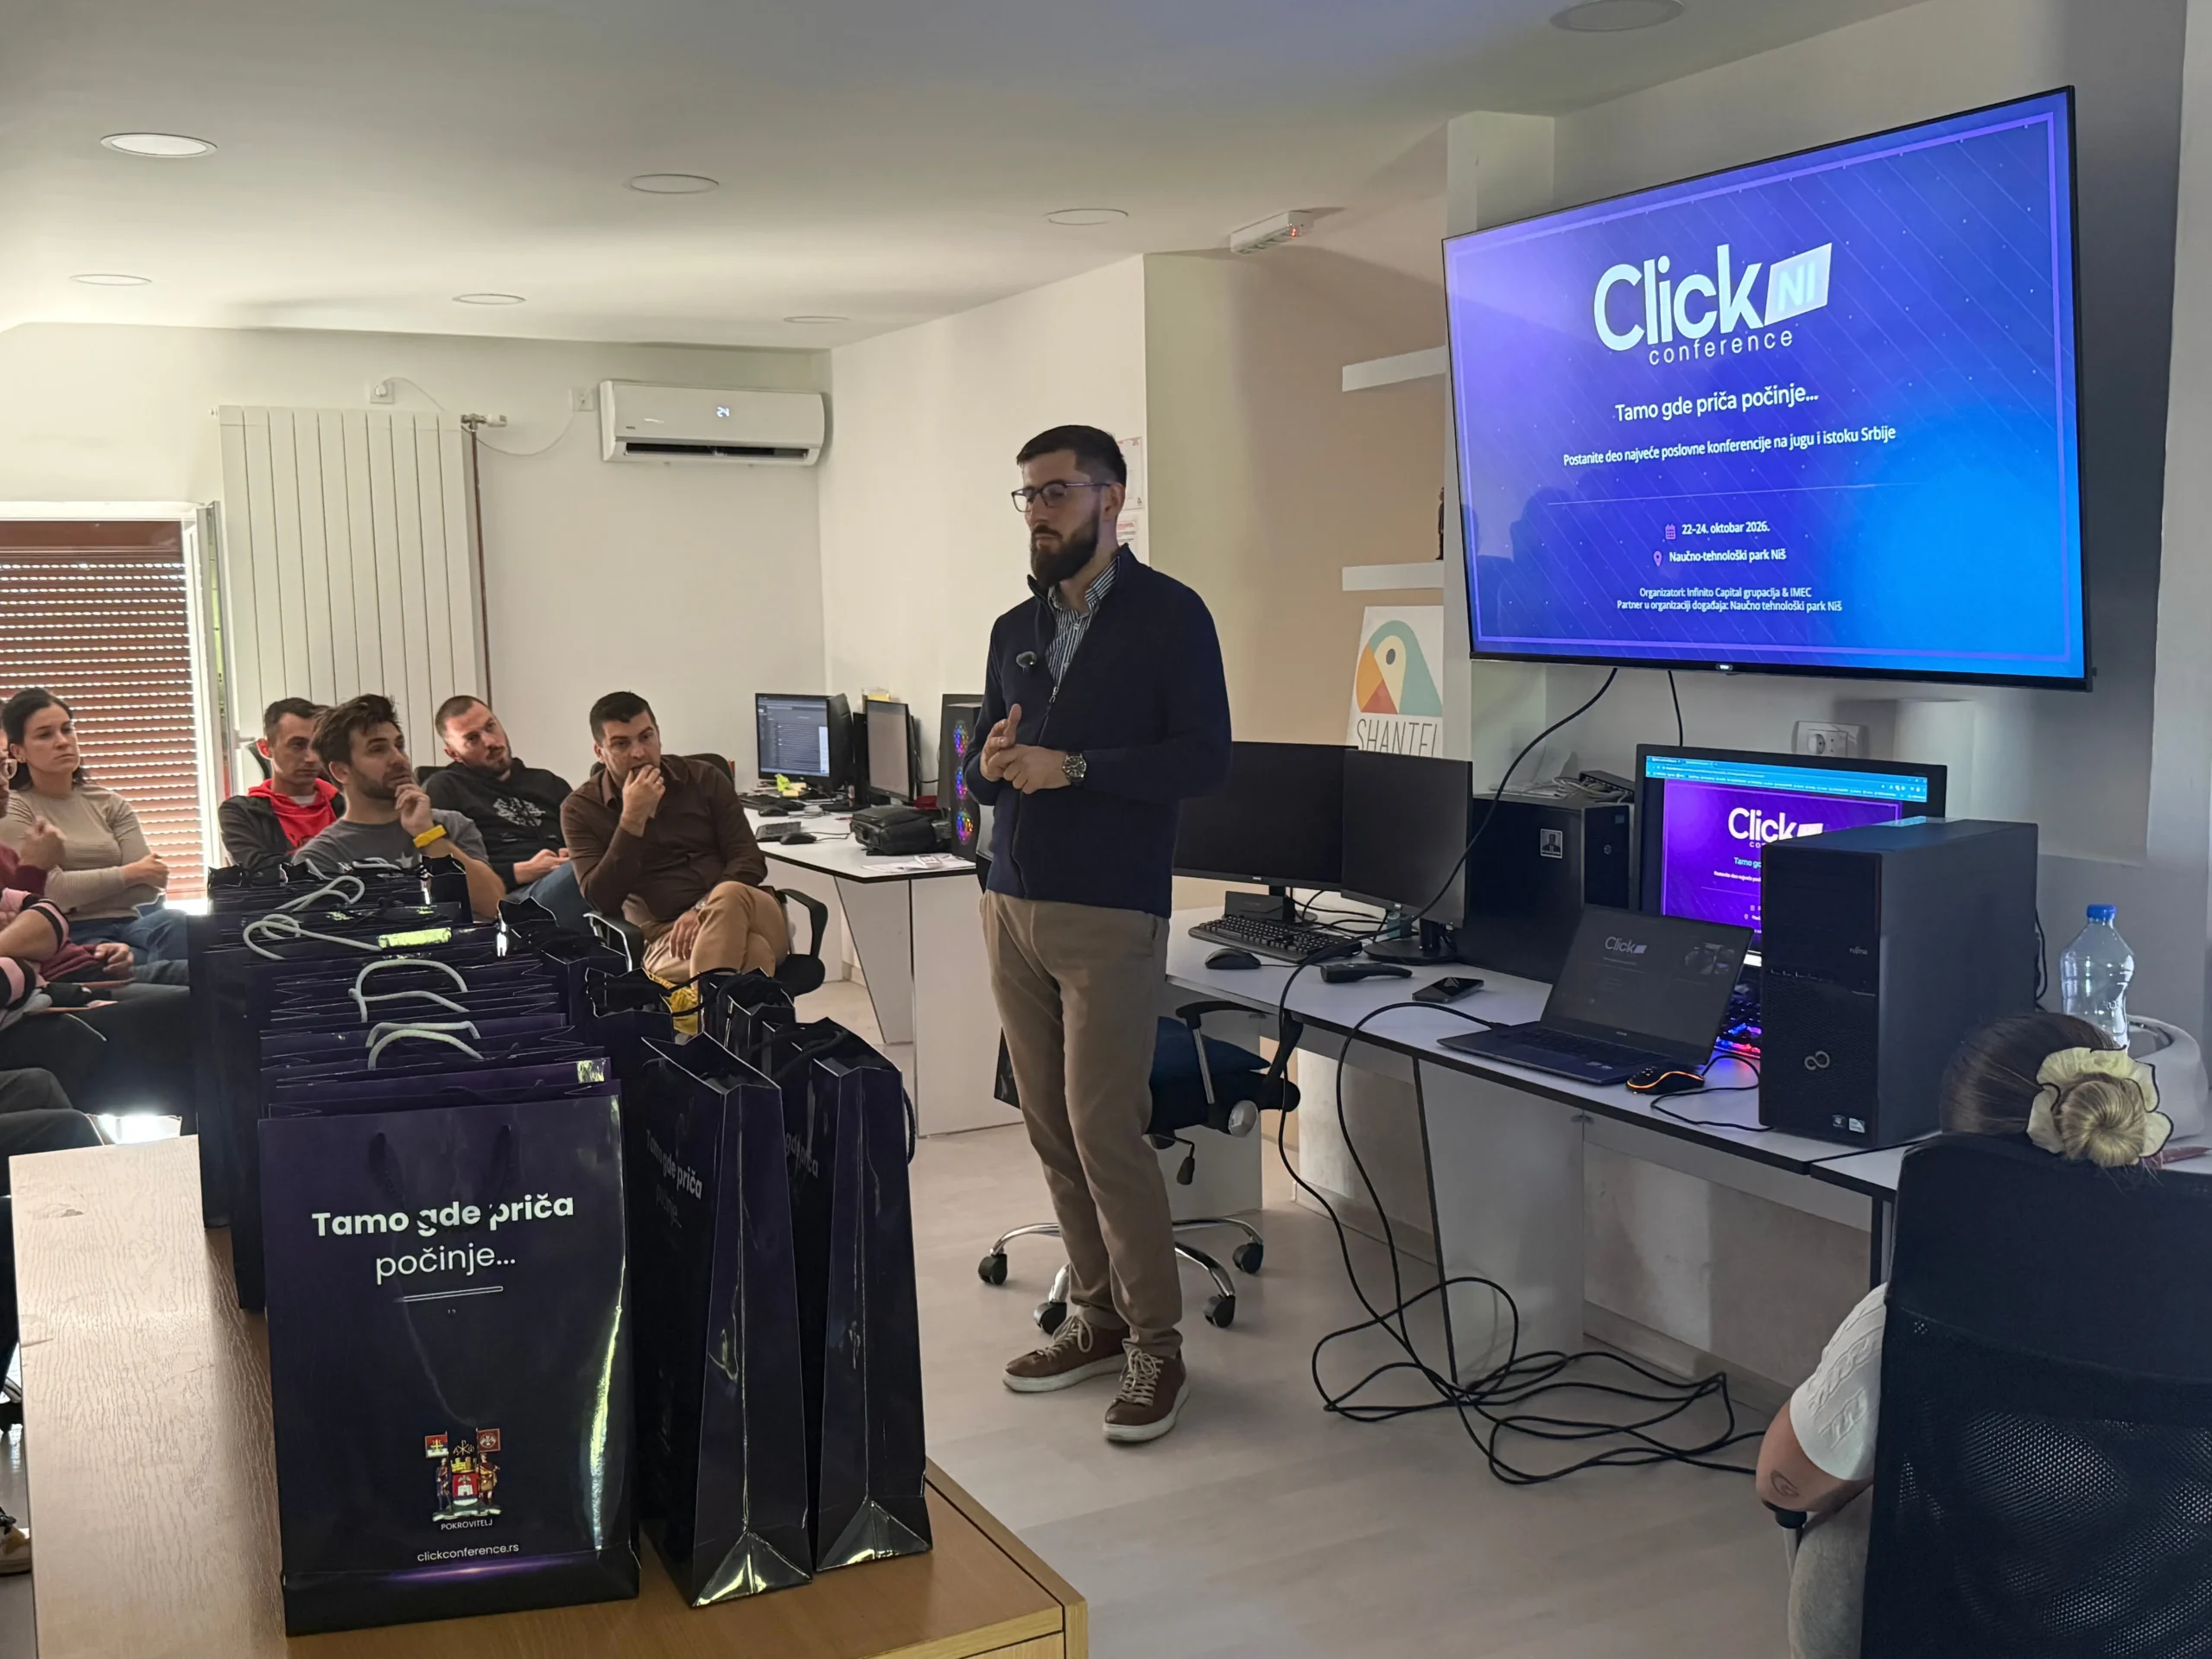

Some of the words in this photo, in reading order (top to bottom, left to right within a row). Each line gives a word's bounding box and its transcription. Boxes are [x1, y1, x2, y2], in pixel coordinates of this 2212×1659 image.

[1593, 244, 1764, 352] Click
[1649, 330, 1793, 365] conference
[1614, 404, 1659, 422] Tamo
[1662, 396, 1694, 421] gde
[1696, 391, 1738, 417] priča
[1741, 383, 1819, 412] počinje...
[1563, 451, 1605, 466] Postanite
[1605, 449, 1623, 463] deo
[1624, 446, 1660, 463] najveće
[1662, 442, 1706, 461] poslovne
[1707, 436, 1772, 454] konferencije
[1773, 436, 1788, 448] na
[1789, 433, 1815, 451] jugu
[1816, 430, 1821, 445] i
[1822, 428, 1859, 444] istoku
[1860, 425, 1897, 443] Srbije
[1710, 522, 1745, 534] oktobar
[1745, 521, 1770, 532] 2026.
[1669, 549, 1747, 562] Naučno-tehnološki
[1748, 549, 1770, 563] park
[1770, 548, 1787, 560] Niš
[1617, 600, 1643, 609] Partner
[1650, 600, 1691, 612] organizaciji
[1730, 600, 1761, 610] Naučno
[1762, 600, 1805, 611] tehnološki
[1806, 601, 1827, 613] park
[1827, 600, 1843, 612] Niš
[1639, 588, 1686, 600] Organizatori:
[1687, 587, 1714, 597] Infinito
[1714, 587, 1742, 600] Capital
[1743, 588, 1780, 601] grupacija
[1782, 588, 1789, 597] &
[1789, 588, 1812, 598] IMEC
[1728, 807, 1797, 842] Click
[1605, 936, 1637, 954] Click
[677, 1165, 703, 1200] priča
[312, 1211, 410, 1236] Tamo
[416, 1201, 481, 1236] gde
[489, 1192, 575, 1231] priča
[376, 1243, 516, 1286] počinje...
[441, 1518, 493, 1530] POKROVITELJ
[416, 1543, 519, 1562] clickconference.rs
